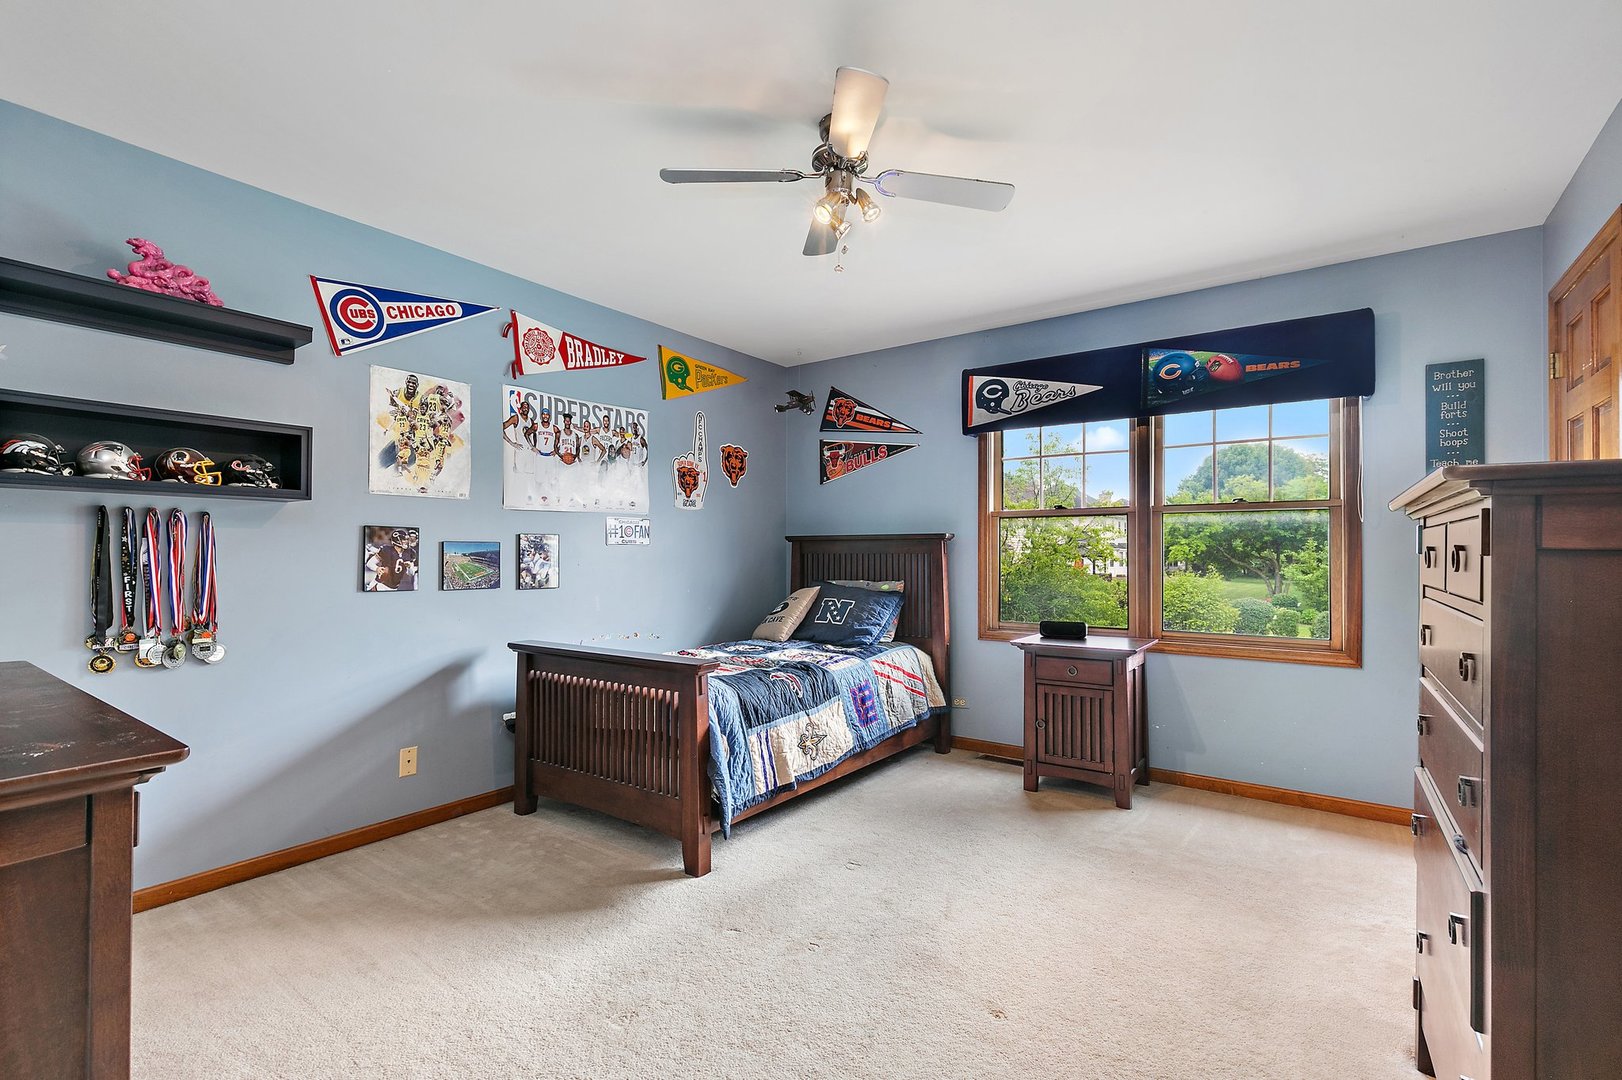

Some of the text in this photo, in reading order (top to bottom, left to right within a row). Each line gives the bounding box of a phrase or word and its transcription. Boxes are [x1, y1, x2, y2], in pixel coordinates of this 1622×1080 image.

[386, 304, 456, 319] CHICAGO
[565, 335, 625, 368] BRADLEY
[1245, 360, 1300, 372] BEARS
[1434, 369, 1475, 380] Brother
[1013, 381, 1049, 393] Chicago
[1458, 381, 1476, 391] you
[1010, 386, 1076, 412] Bears
[1441, 401, 1467, 410] Build
[524, 392, 646, 438] SUPERSTARS
[855, 413, 891, 429] BEARS
[1440, 410, 1468, 419] forts
[1440, 428, 1469, 438] Shoot
[1440, 438, 1469, 447] hoops
[846, 445, 888, 473] BULLS
[1430, 459, 1460, 468] Teach
[634, 524, 650, 538] FAN
[394, 558, 402, 574] 6
[123, 576, 133, 612] FIRST
